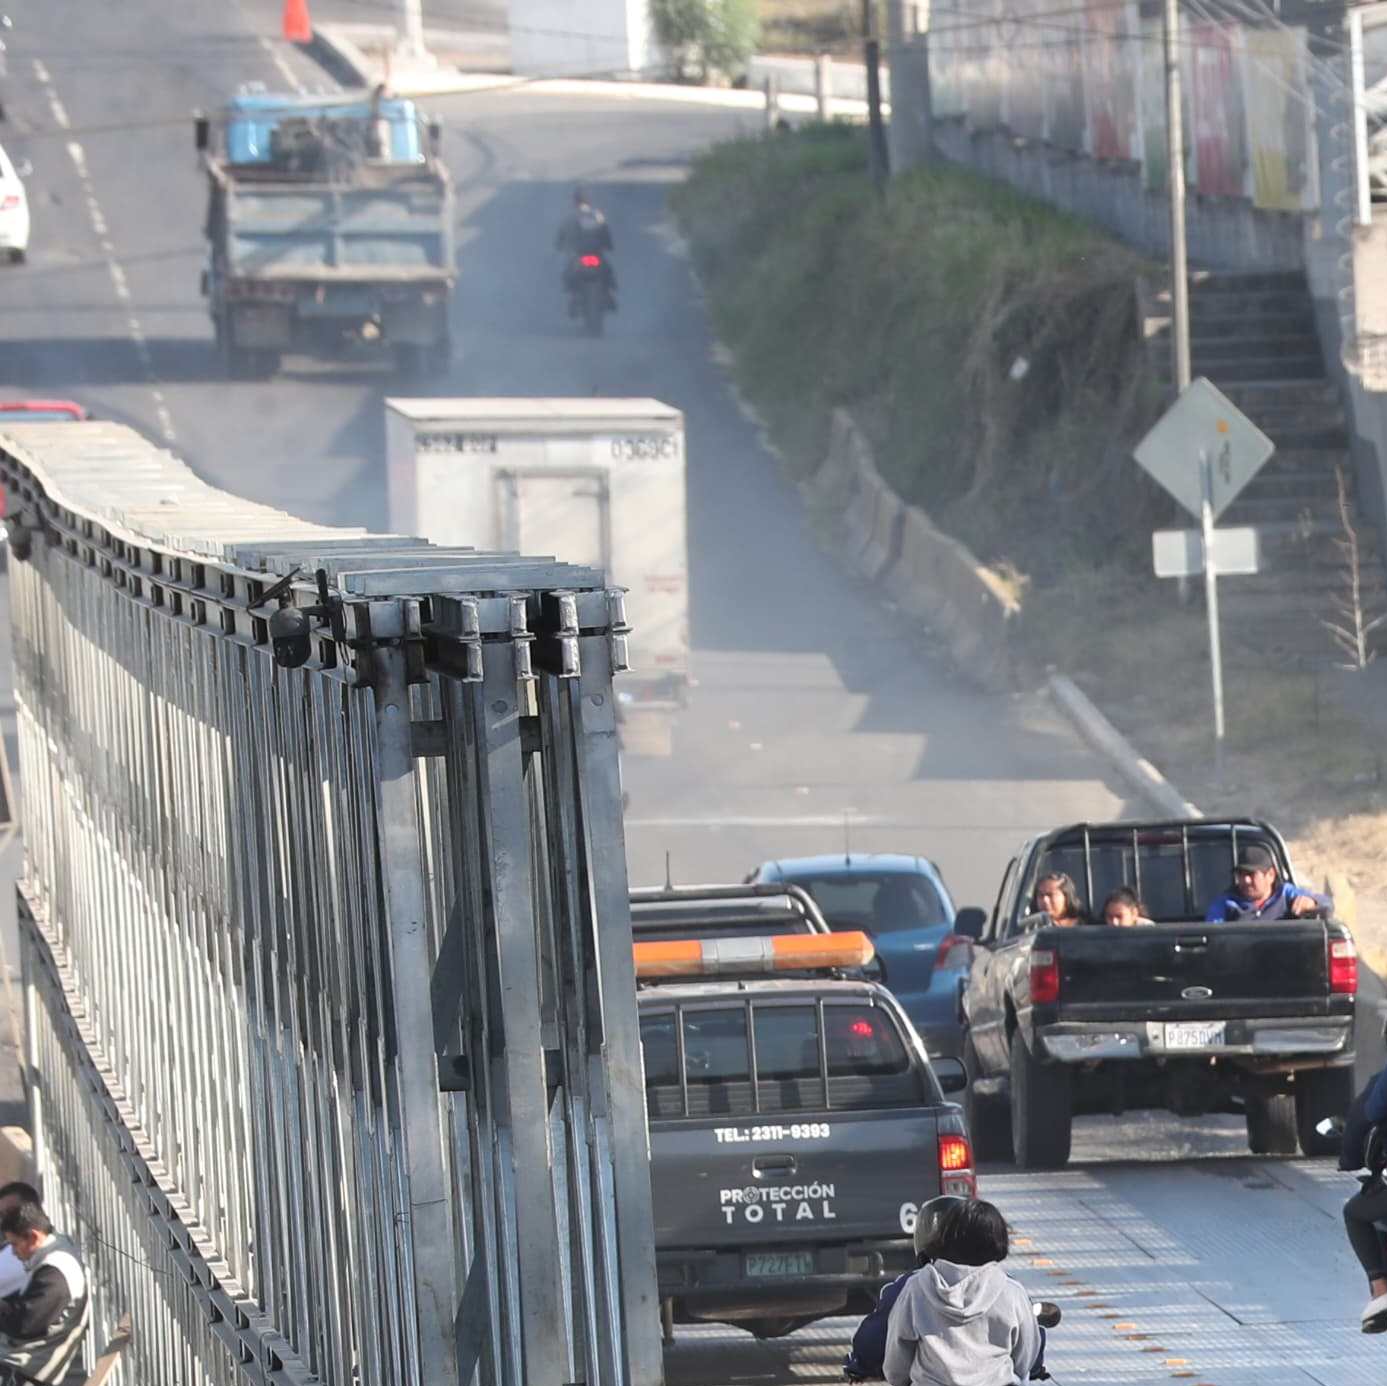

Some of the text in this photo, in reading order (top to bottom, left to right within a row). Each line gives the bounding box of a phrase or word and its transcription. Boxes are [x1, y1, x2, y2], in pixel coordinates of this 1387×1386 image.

[751, 1123, 831, 1141] 2311-9393
[720, 1181, 835, 1204] PROTECCIÓN
[721, 1200, 836, 1225] TOTAL
